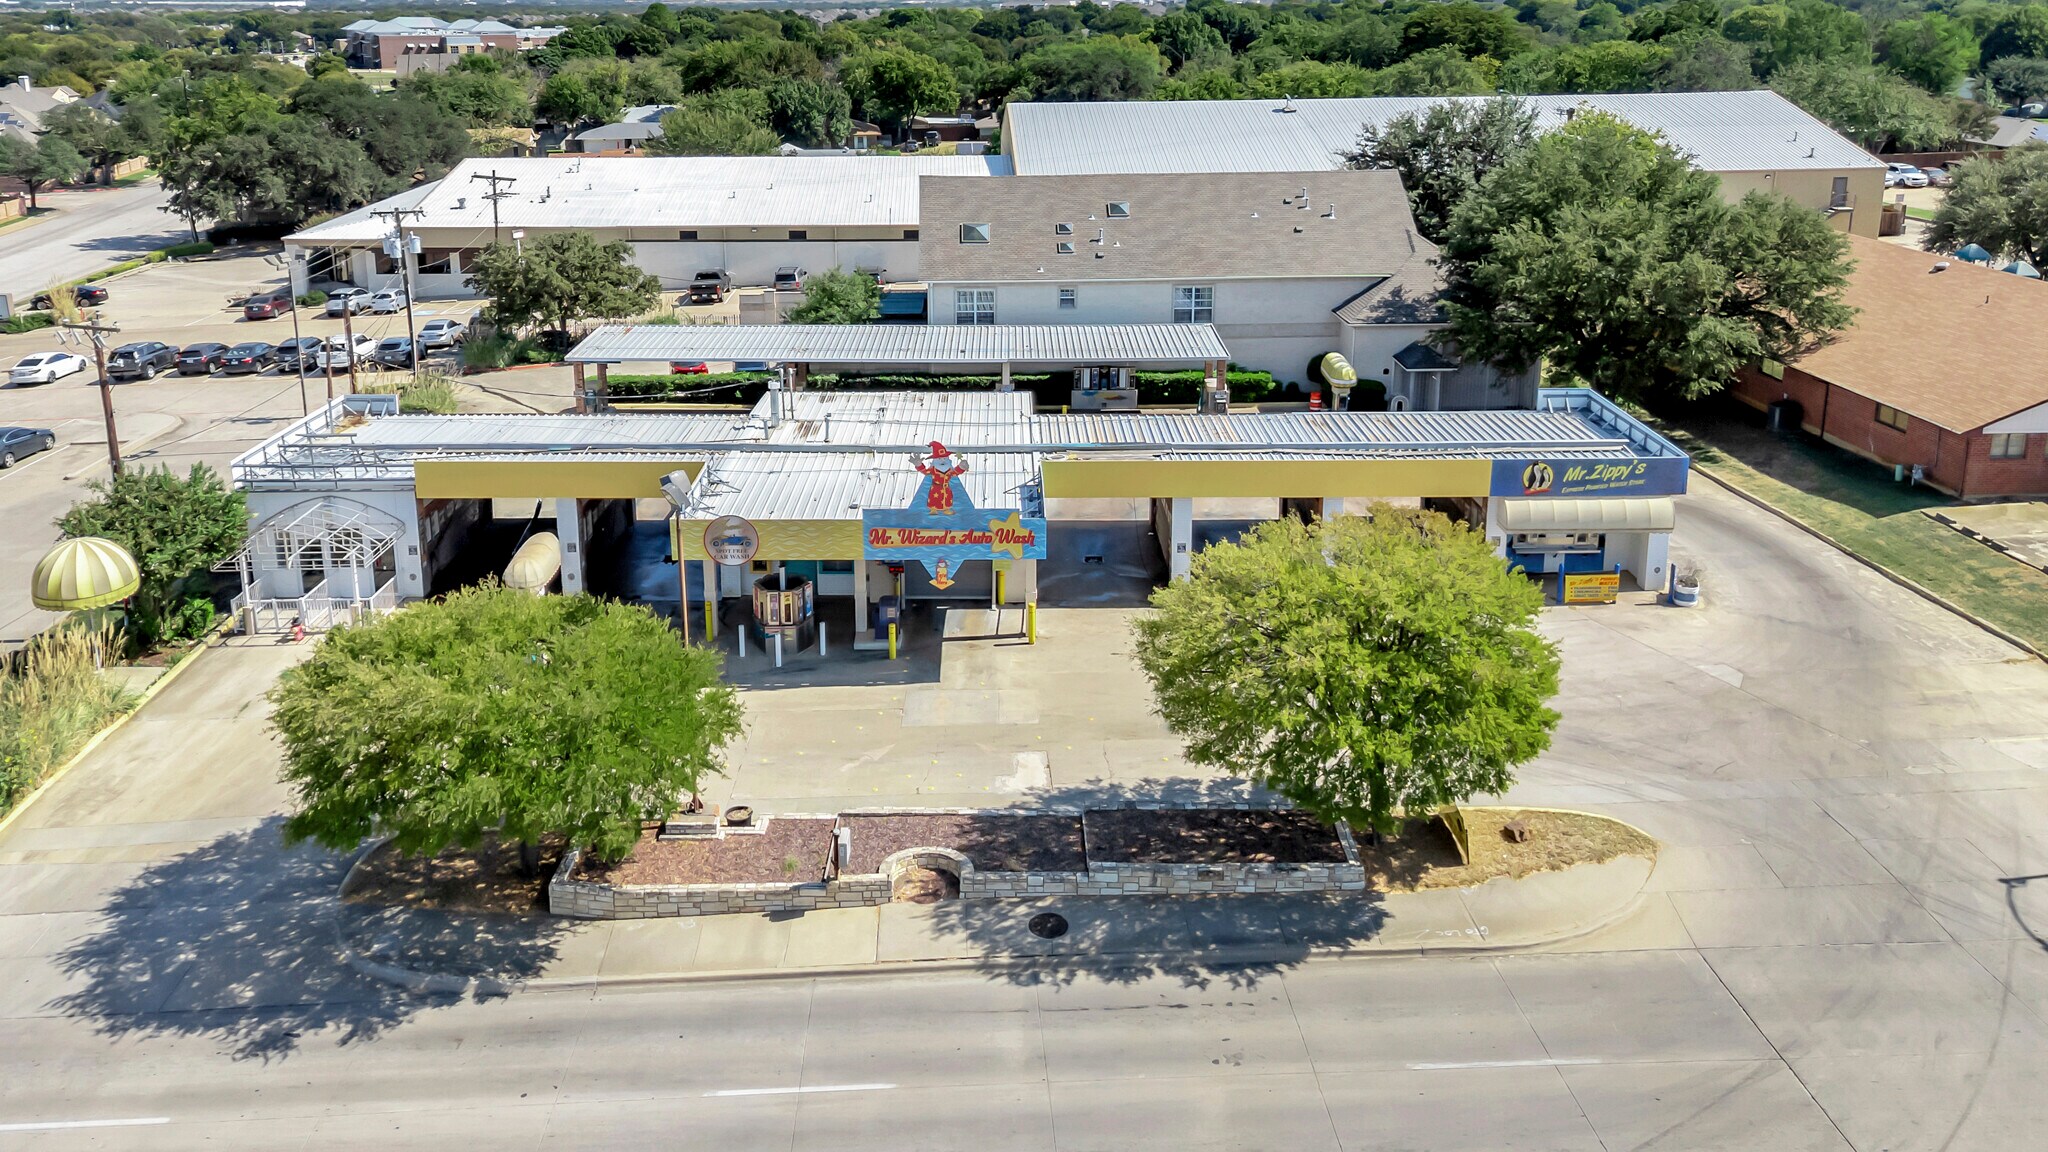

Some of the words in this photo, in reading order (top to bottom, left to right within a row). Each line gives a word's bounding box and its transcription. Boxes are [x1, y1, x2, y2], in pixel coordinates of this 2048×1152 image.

[868, 528, 895, 545] Mr.
[898, 528, 956, 545] Wizard's
[959, 528, 993, 545] Auto
[995, 528, 1036, 547] Wash
